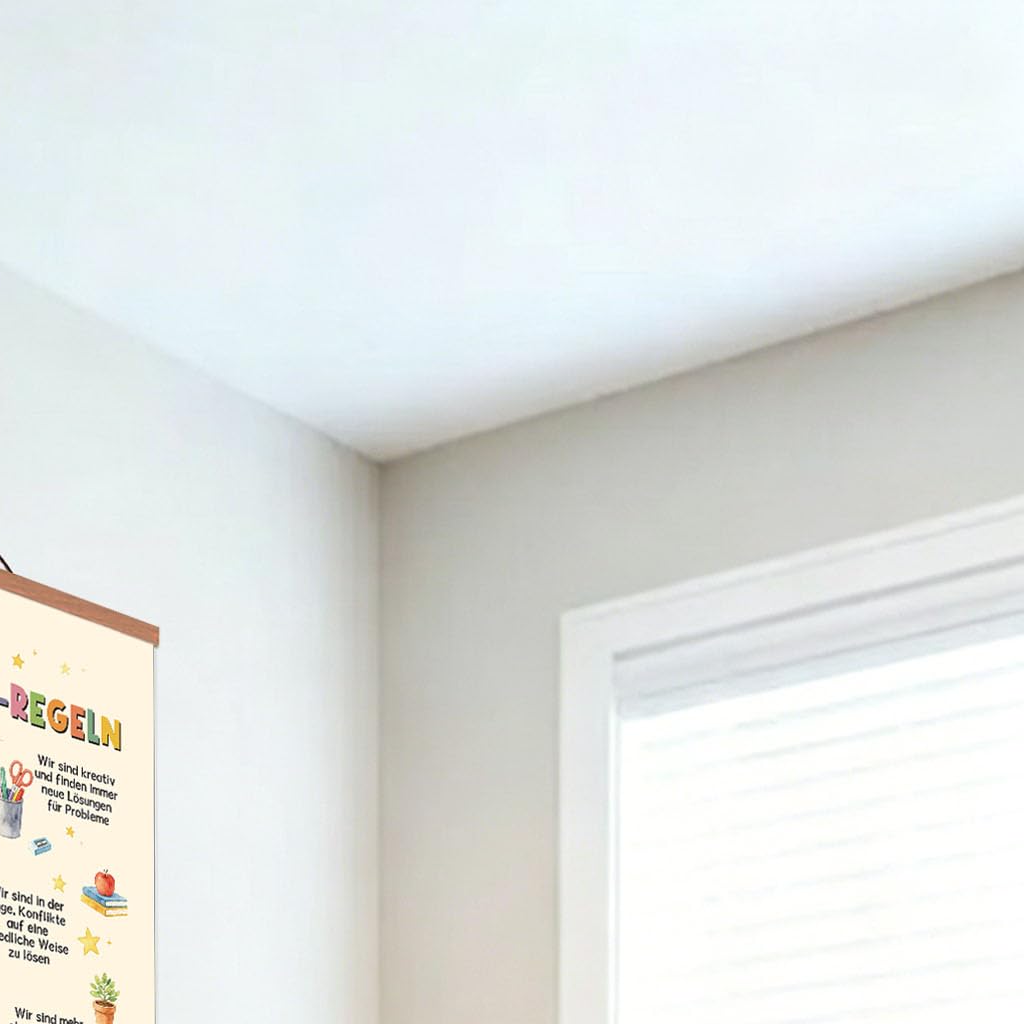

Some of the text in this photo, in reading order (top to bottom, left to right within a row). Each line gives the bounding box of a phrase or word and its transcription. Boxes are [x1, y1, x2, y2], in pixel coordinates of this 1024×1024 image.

[38, 754, 116, 787] Wir sind kreativ
[41, 786, 112, 813] neue Lösungen
[8, 949, 50, 964] zu lösen
[38, 938, 69, 955] Weise
